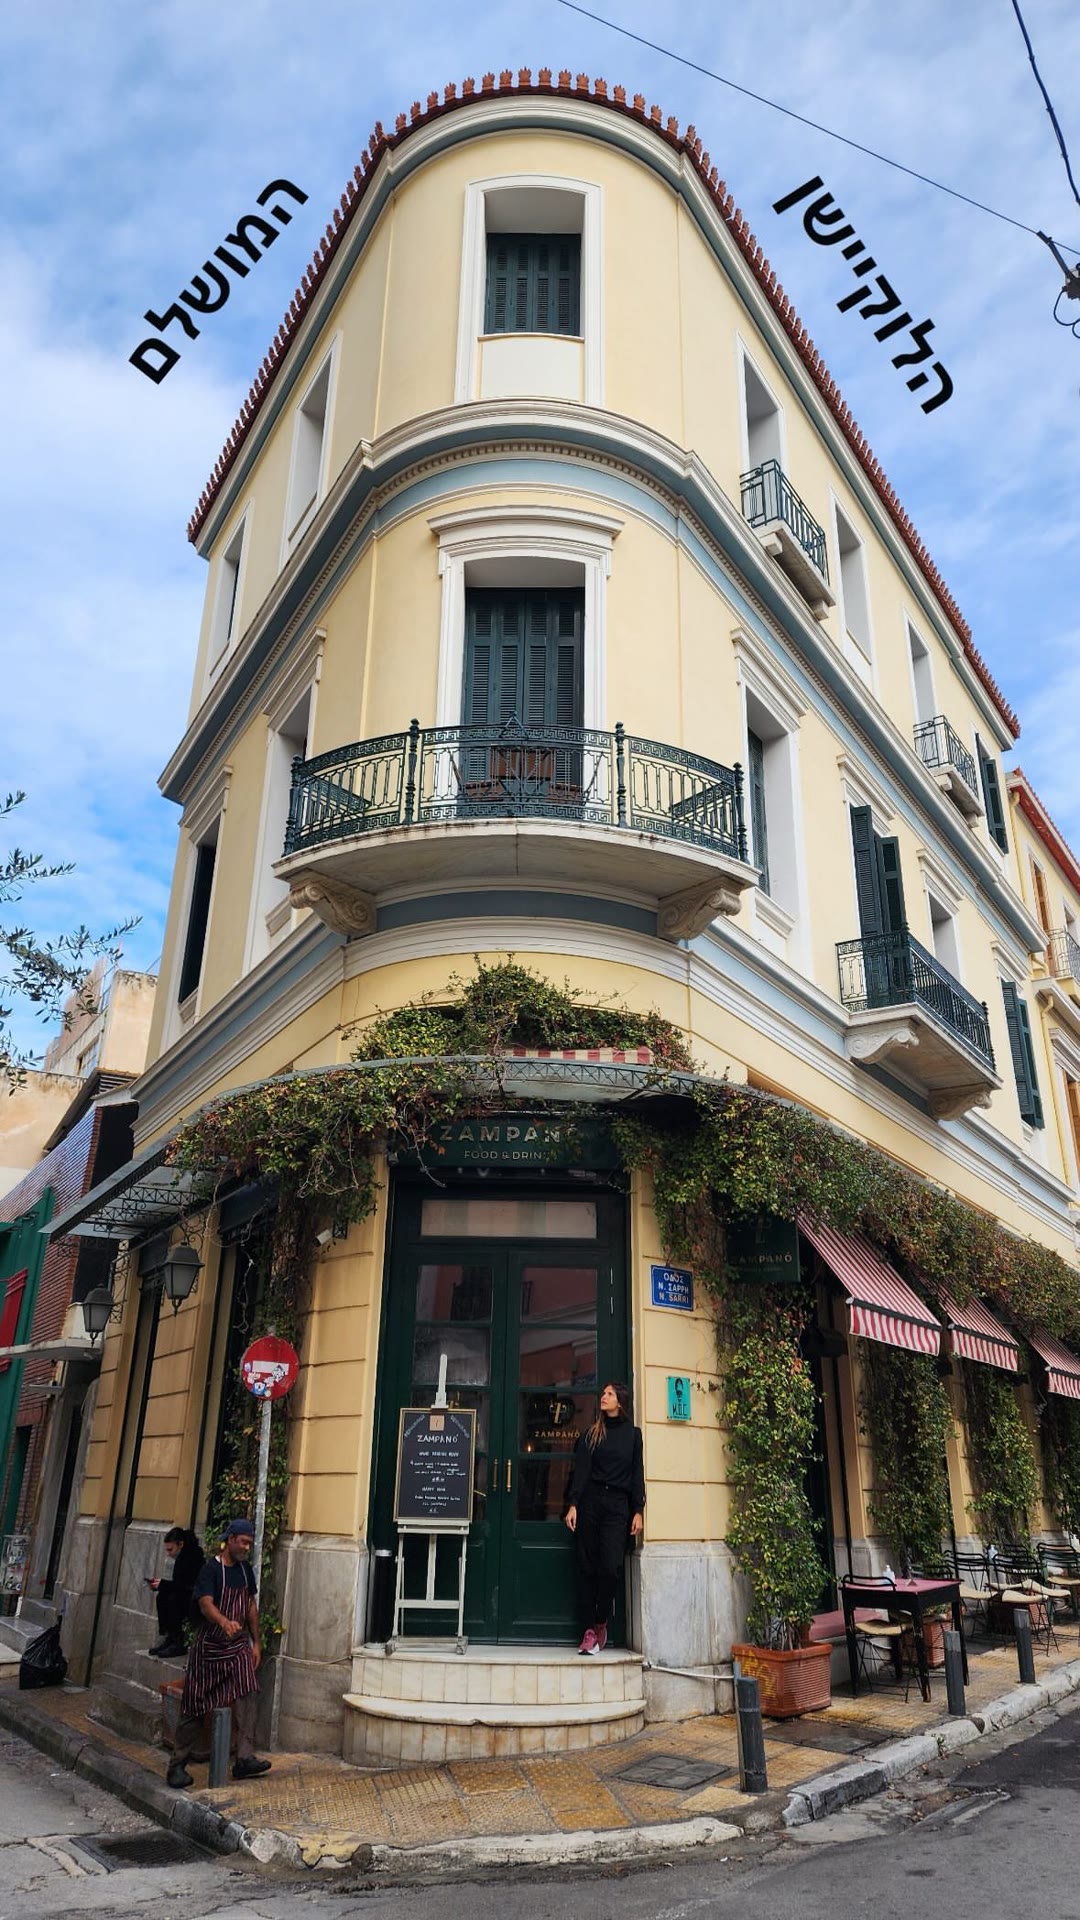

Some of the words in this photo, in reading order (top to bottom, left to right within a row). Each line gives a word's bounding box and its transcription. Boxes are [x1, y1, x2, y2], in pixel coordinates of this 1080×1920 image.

[464, 1150, 498, 1159] FOOD
[502, 1151, 510, 1160] &
[512, 1151, 547, 1160] DRIN
[663, 1272, 684, 1284] ΟΔΟΣ
[668, 1293, 689, 1304] SARRI
